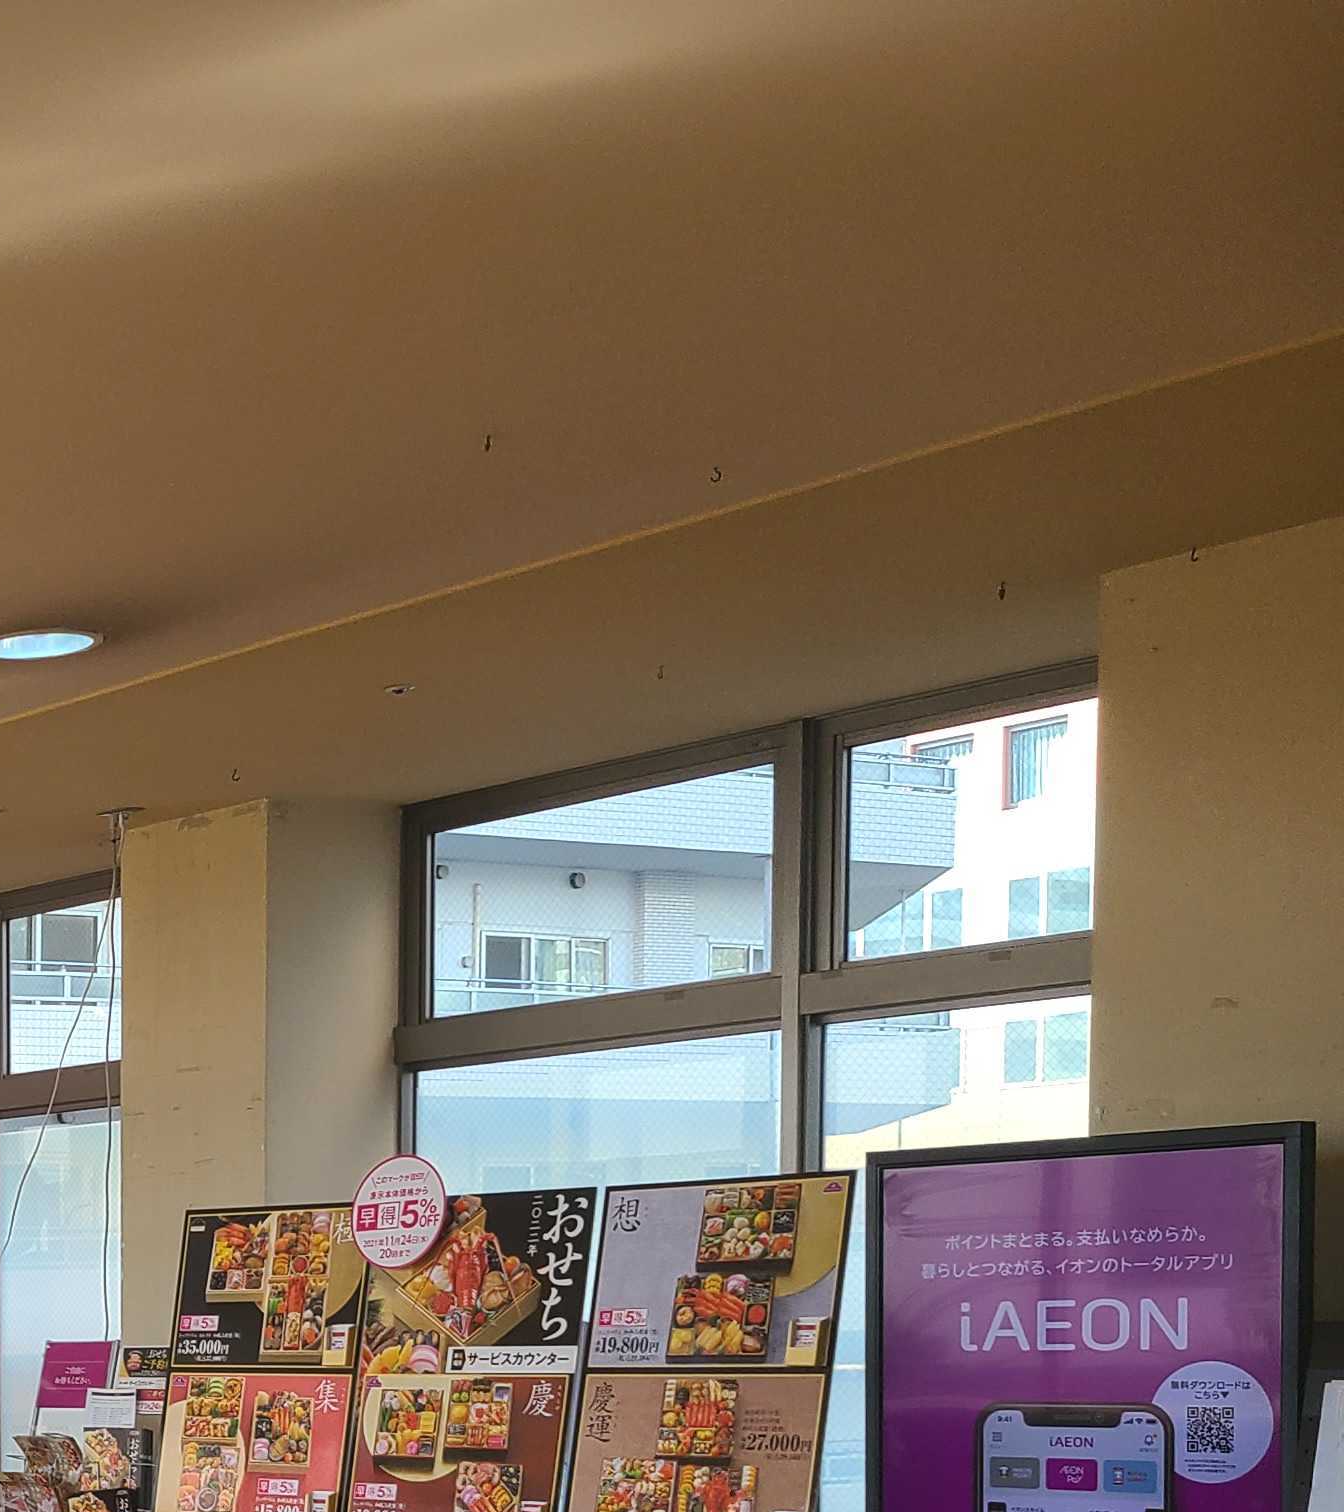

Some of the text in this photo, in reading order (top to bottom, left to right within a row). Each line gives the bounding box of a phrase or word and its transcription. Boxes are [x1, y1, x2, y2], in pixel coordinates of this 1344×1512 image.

[611, 1196, 642, 1233] 想
[944, 1226, 1207, 1252] ポイントまとまる。支払いなめらか。
[536, 1193, 589, 1342] おせち
[921, 1253, 1235, 1280] 暮らしとつながる、イオンのトータルアプリ
[959, 1296, 1190, 1353] iAEON
[467, 1351, 570, 1368] サービスカウンター
[314, 1378, 341, 1415] 集
[521, 1379, 556, 1418] 慶
[584, 1381, 616, 1443] 慶運
[1048, 1436, 1095, 1449] iAEON
